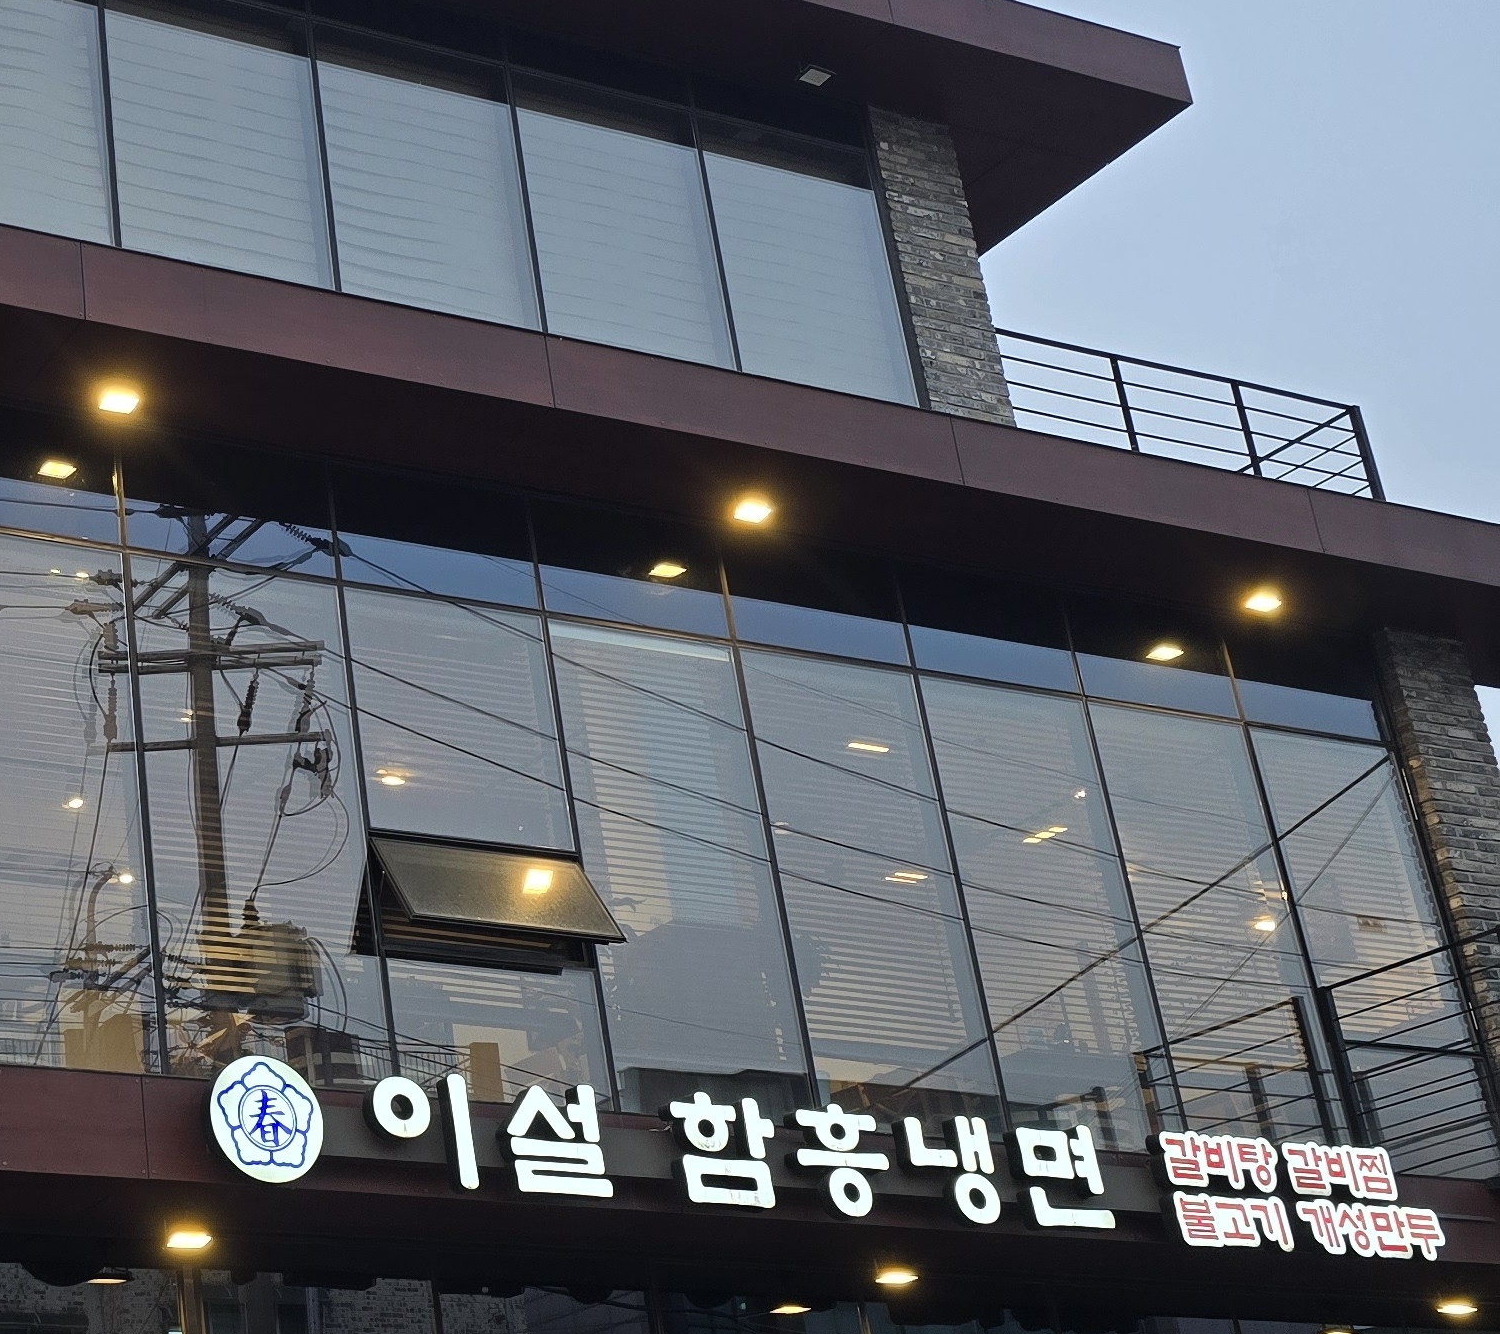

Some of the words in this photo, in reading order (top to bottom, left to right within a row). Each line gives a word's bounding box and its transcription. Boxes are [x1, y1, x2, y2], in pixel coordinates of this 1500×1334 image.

[372, 1071, 614, 1197] 이설
[669, 1090, 1116, 1231] 함흥냉면
[1160, 1127, 1279, 1193] 갈비탕
[1283, 1138, 1399, 1203] 갈비찜
[1175, 1191, 1295, 1254] 불고기
[1295, 1197, 1445, 1262] 개성만두
